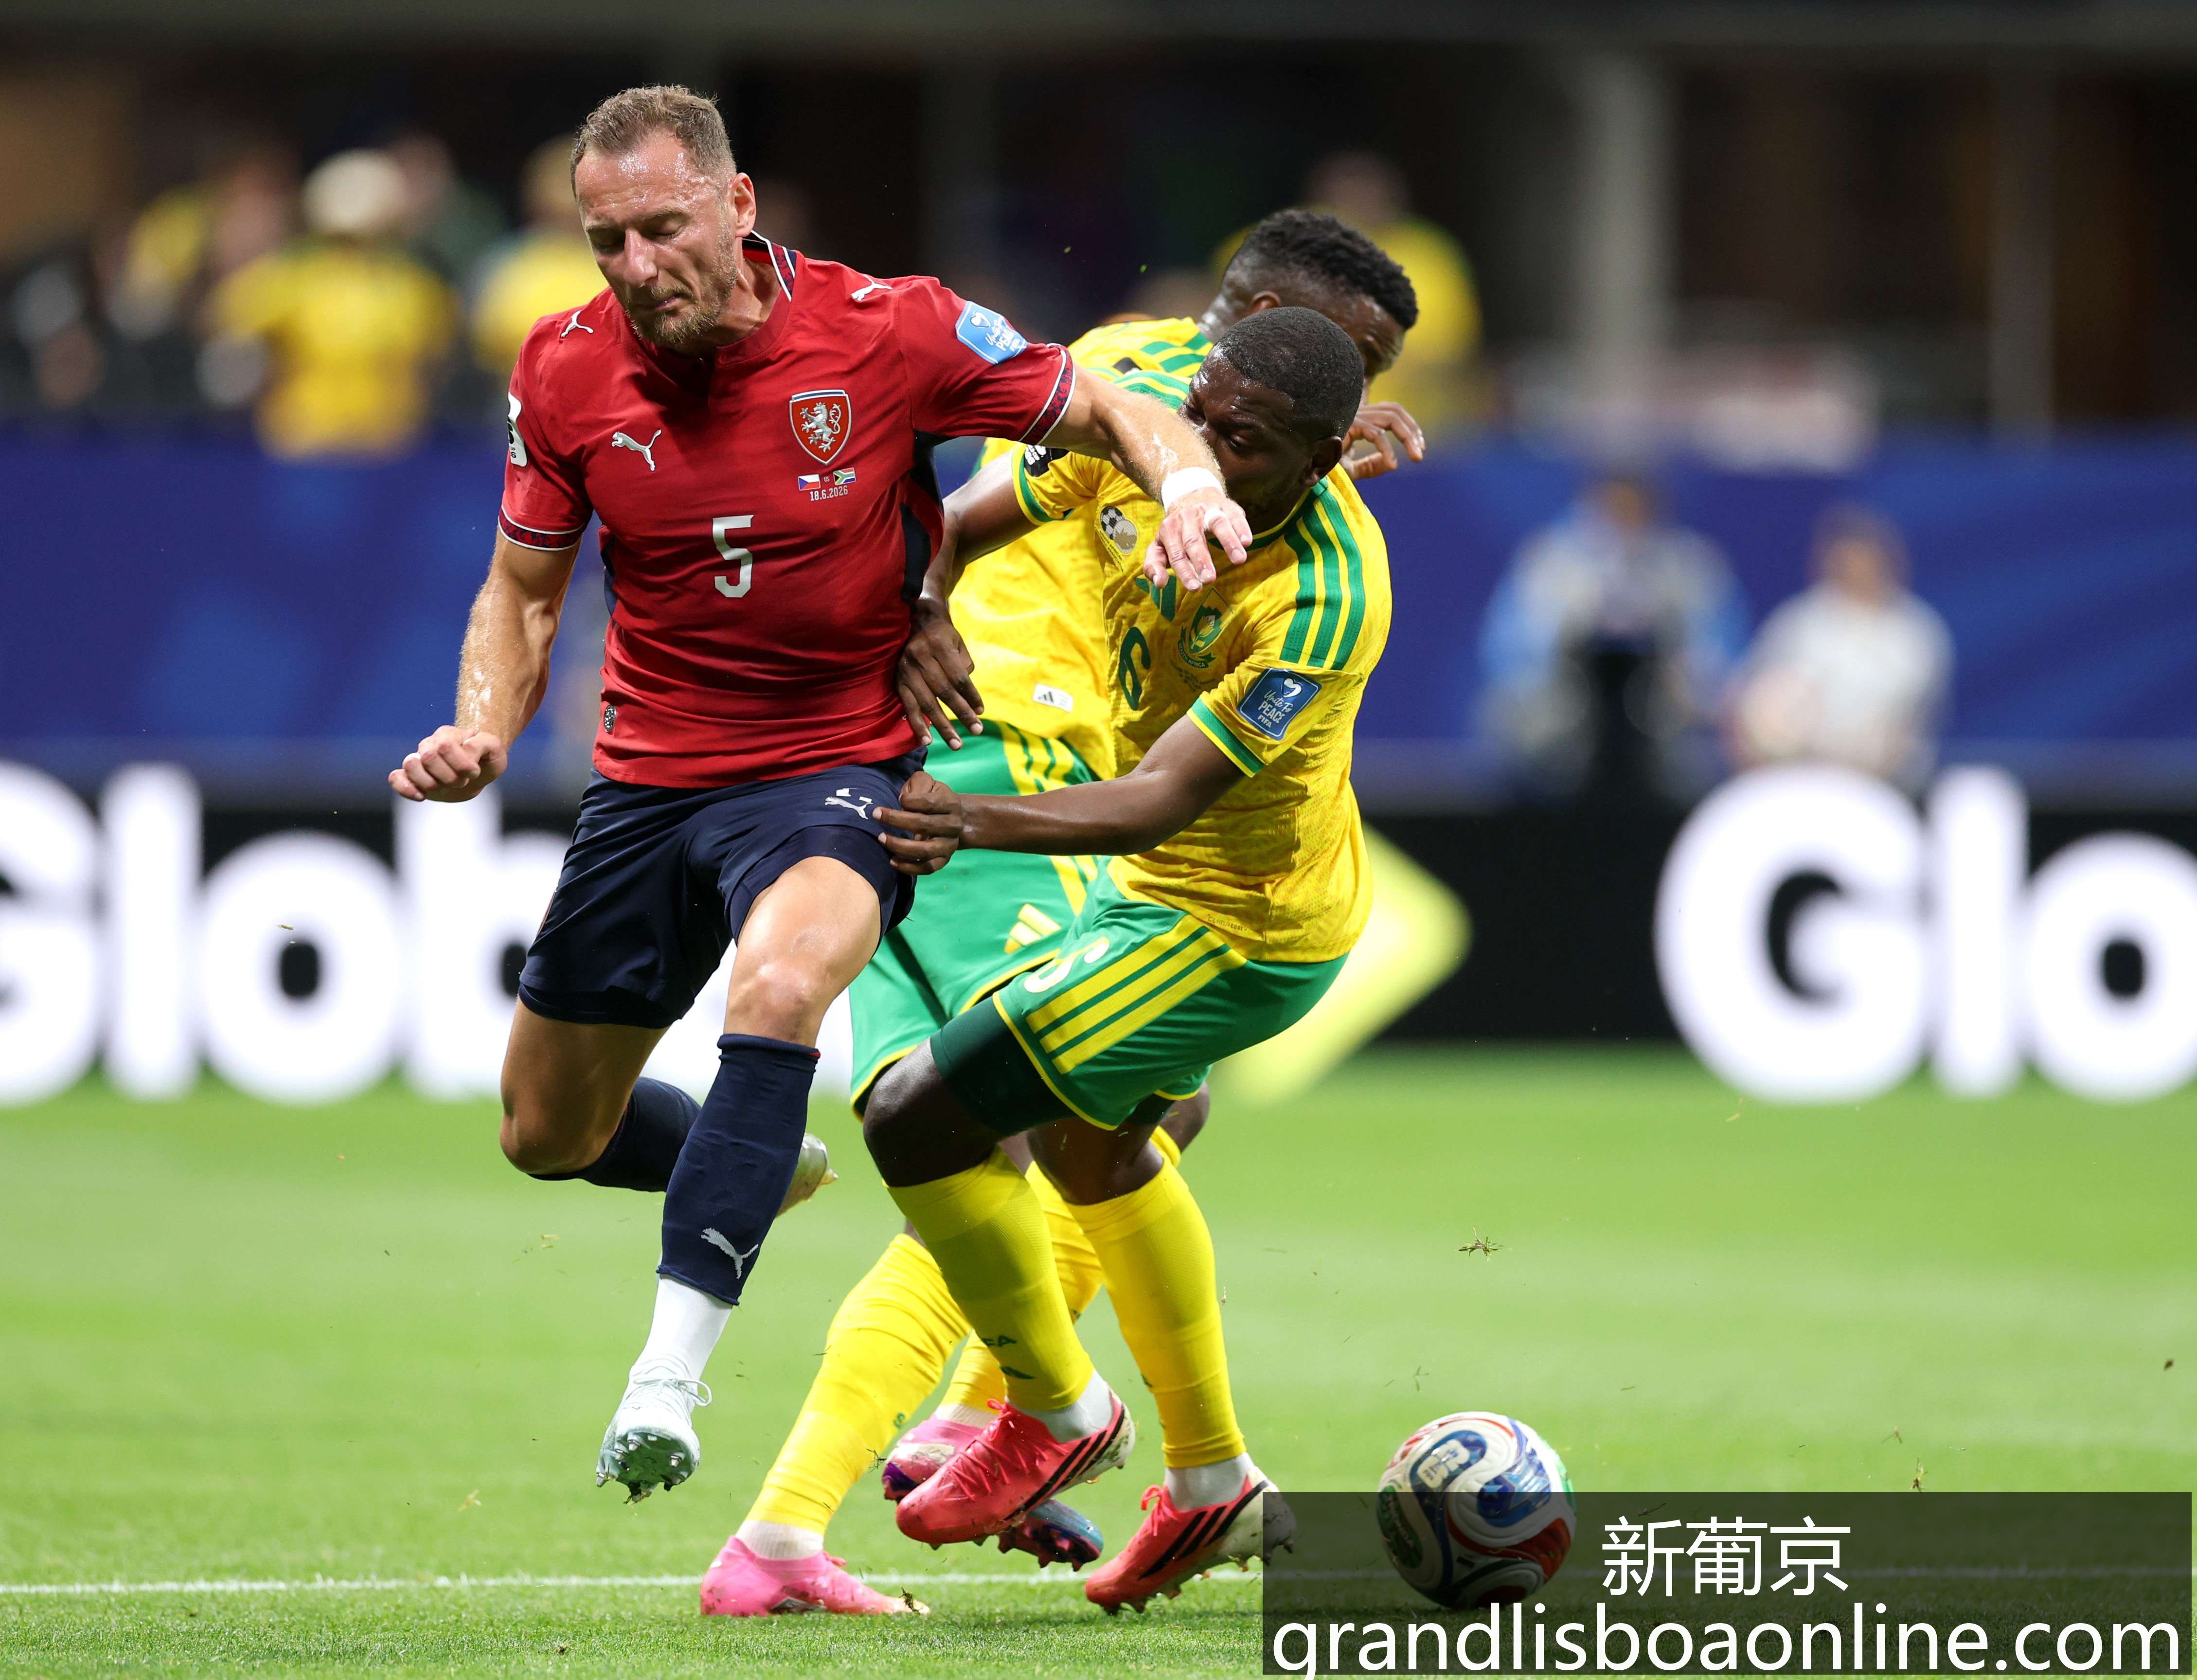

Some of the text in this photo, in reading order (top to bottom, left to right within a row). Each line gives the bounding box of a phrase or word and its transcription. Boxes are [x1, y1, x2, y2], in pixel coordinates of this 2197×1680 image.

[810, 485, 848, 501] 18.6.2026
[713, 515, 754, 598] 5
[1119, 626, 1151, 710] 6
[1265, 690, 1285, 708] Unite
[1258, 700, 1285, 724] PEACE
[1258, 715, 1272, 728] FIFA
